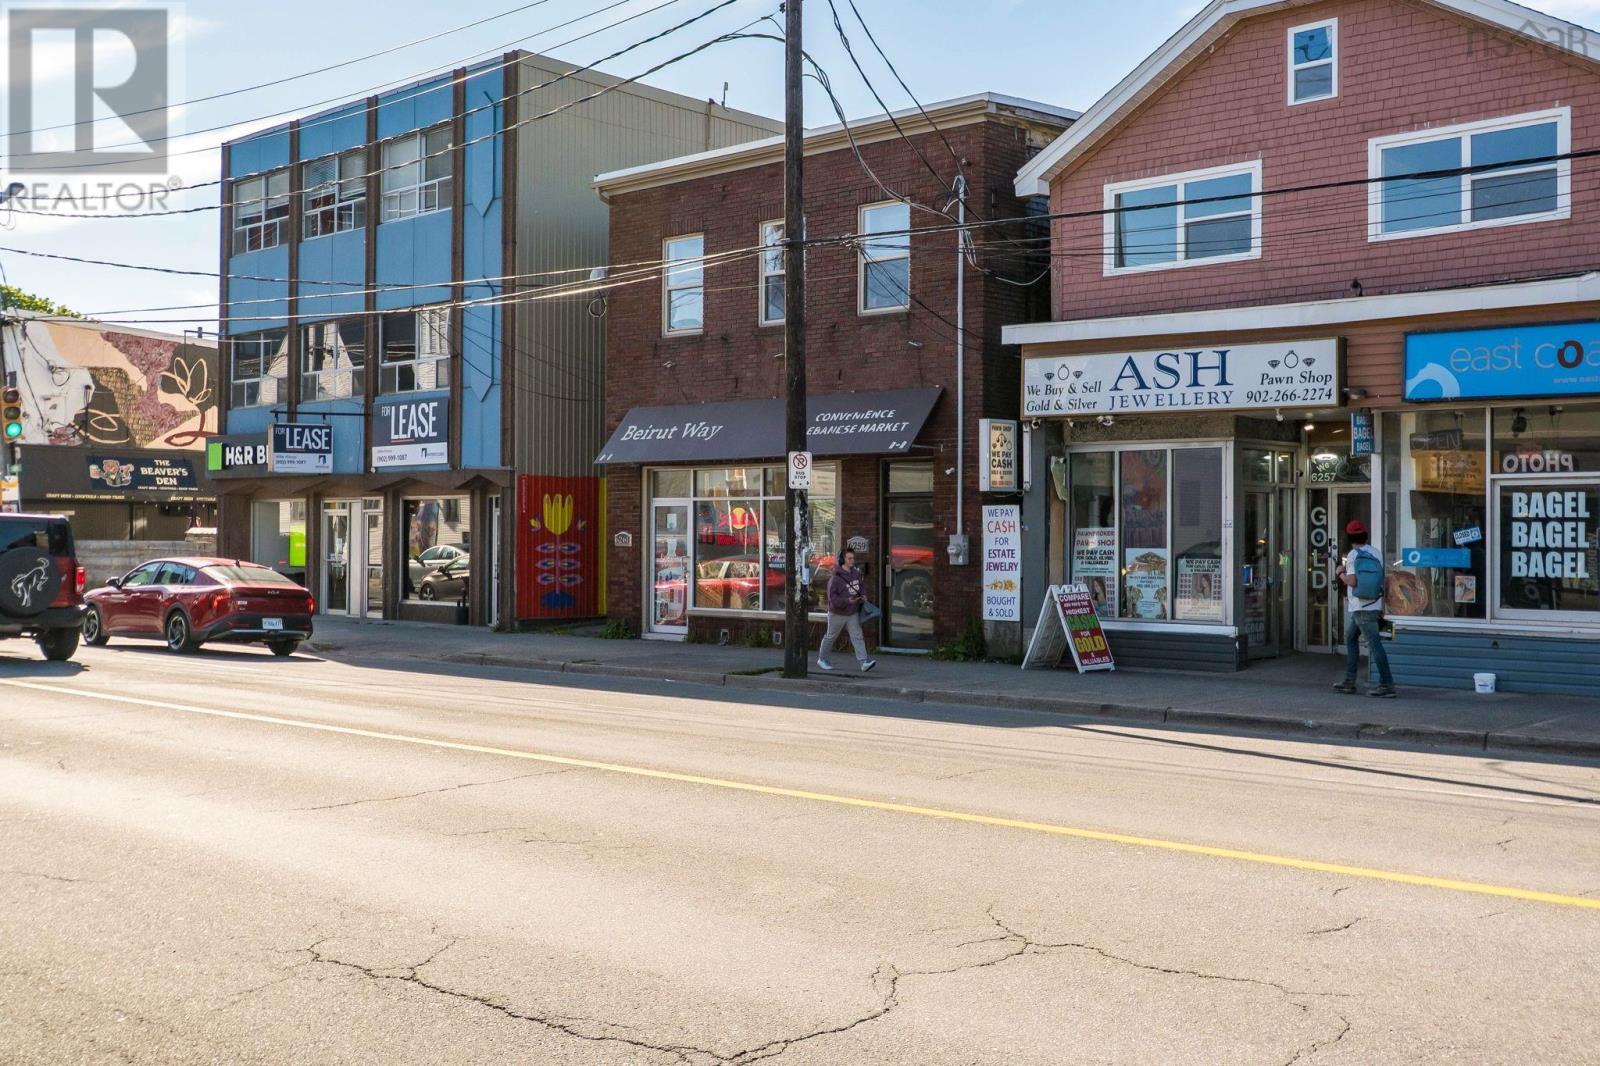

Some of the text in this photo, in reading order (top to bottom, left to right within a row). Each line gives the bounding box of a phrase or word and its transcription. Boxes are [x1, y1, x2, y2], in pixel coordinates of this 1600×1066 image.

[1450, 336, 1522, 373] east
[1109, 350, 1234, 391] ASH
[1260, 370, 1333, 386] Pawn Shop
[1027, 381, 1102, 396] We Buy & Sell
[1246, 388, 1333, 403] 902-266-2274
[1026, 397, 1098, 412] Gold & Silver
[1109, 389, 1234, 410] JEWELLERY
[382, 402, 438, 440] FOR LEASE
[815, 409, 897, 422] CONVENIENCE
[620, 422, 724, 441] Beirut Way
[806, 422, 909, 436] EBANESE MARKET
[286, 427, 330, 450] LEASE
[225, 445, 254, 466] H&R
[992, 458, 1013, 469] CASH
[140, 467, 189, 477] BEAVER'S
[1311, 472, 1336, 482] 6257
[156, 477, 178, 485] DEN
[1512, 492, 1590, 518] BAGEL
[988, 509, 1014, 517] WE PAY
[995, 537, 1009, 545] FOR
[1511, 521, 1590, 548] BAGEL
[988, 549, 1016, 558] ESTATE
[1311, 507, 1327, 589] GOLD
[985, 562, 1018, 571] JEWELRY
[1511, 551, 1590, 578] BAGEL
[986, 596, 1016, 605] BOUGHT
[1059, 593, 1090, 602] COMPARE
[988, 608, 1014, 617] & SOLD
[1074, 635, 1105, 652] GOLD
